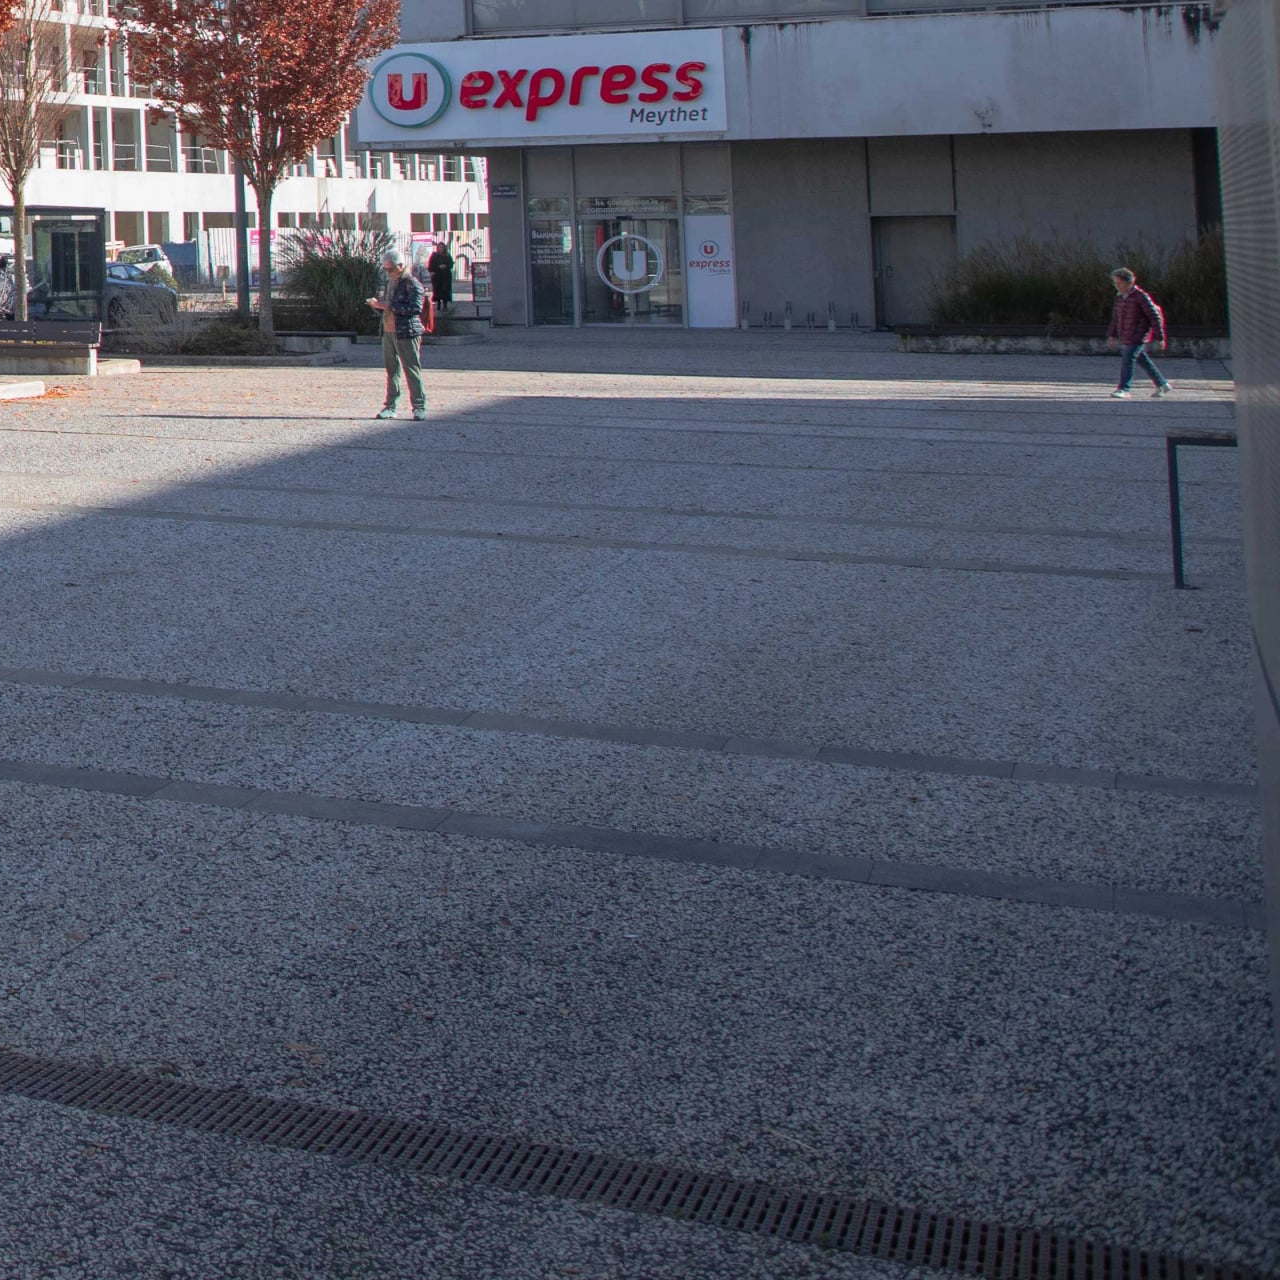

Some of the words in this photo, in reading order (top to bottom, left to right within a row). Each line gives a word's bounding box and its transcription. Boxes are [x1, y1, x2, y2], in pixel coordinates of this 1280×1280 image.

[387, 72, 428, 110] U
[459, 61, 707, 122] express
[629, 106, 709, 126] Meythet
[704, 245, 714, 254] U
[689, 260, 730, 269] express
